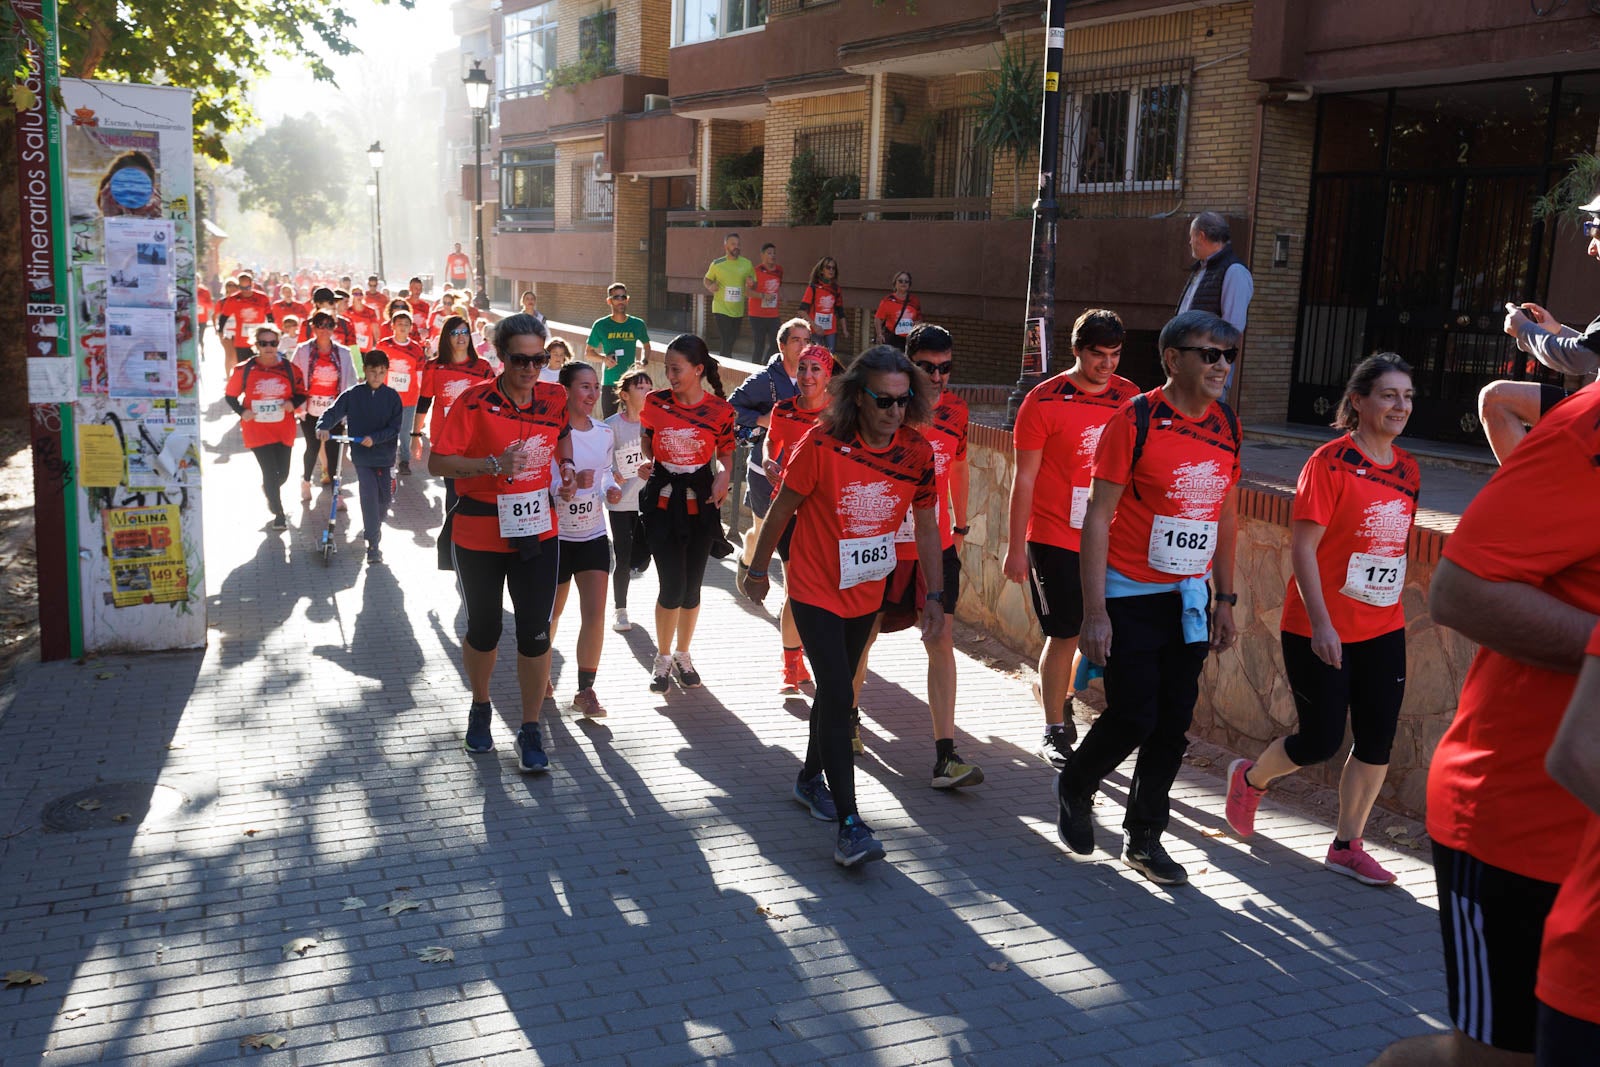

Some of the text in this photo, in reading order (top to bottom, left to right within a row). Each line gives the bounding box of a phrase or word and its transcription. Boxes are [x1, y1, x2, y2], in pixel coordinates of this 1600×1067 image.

[134, 120, 186, 131] Ayuntamiento
[1457, 142, 1469, 162] 2
[29, 305, 64, 315] MPS
[259, 404, 277, 412] 573
[1175, 477, 1226, 490] carrera
[512, 500, 540, 517] 812
[569, 501, 593, 515] 950
[842, 495, 895, 509] carrera
[114, 512, 168, 526] MOLINA
[151, 527, 172, 549] B
[1164, 530, 1208, 550] 1682
[851, 545, 888, 565] 1683
[151, 568, 172, 581] 149
[1365, 566, 1398, 583] 173
